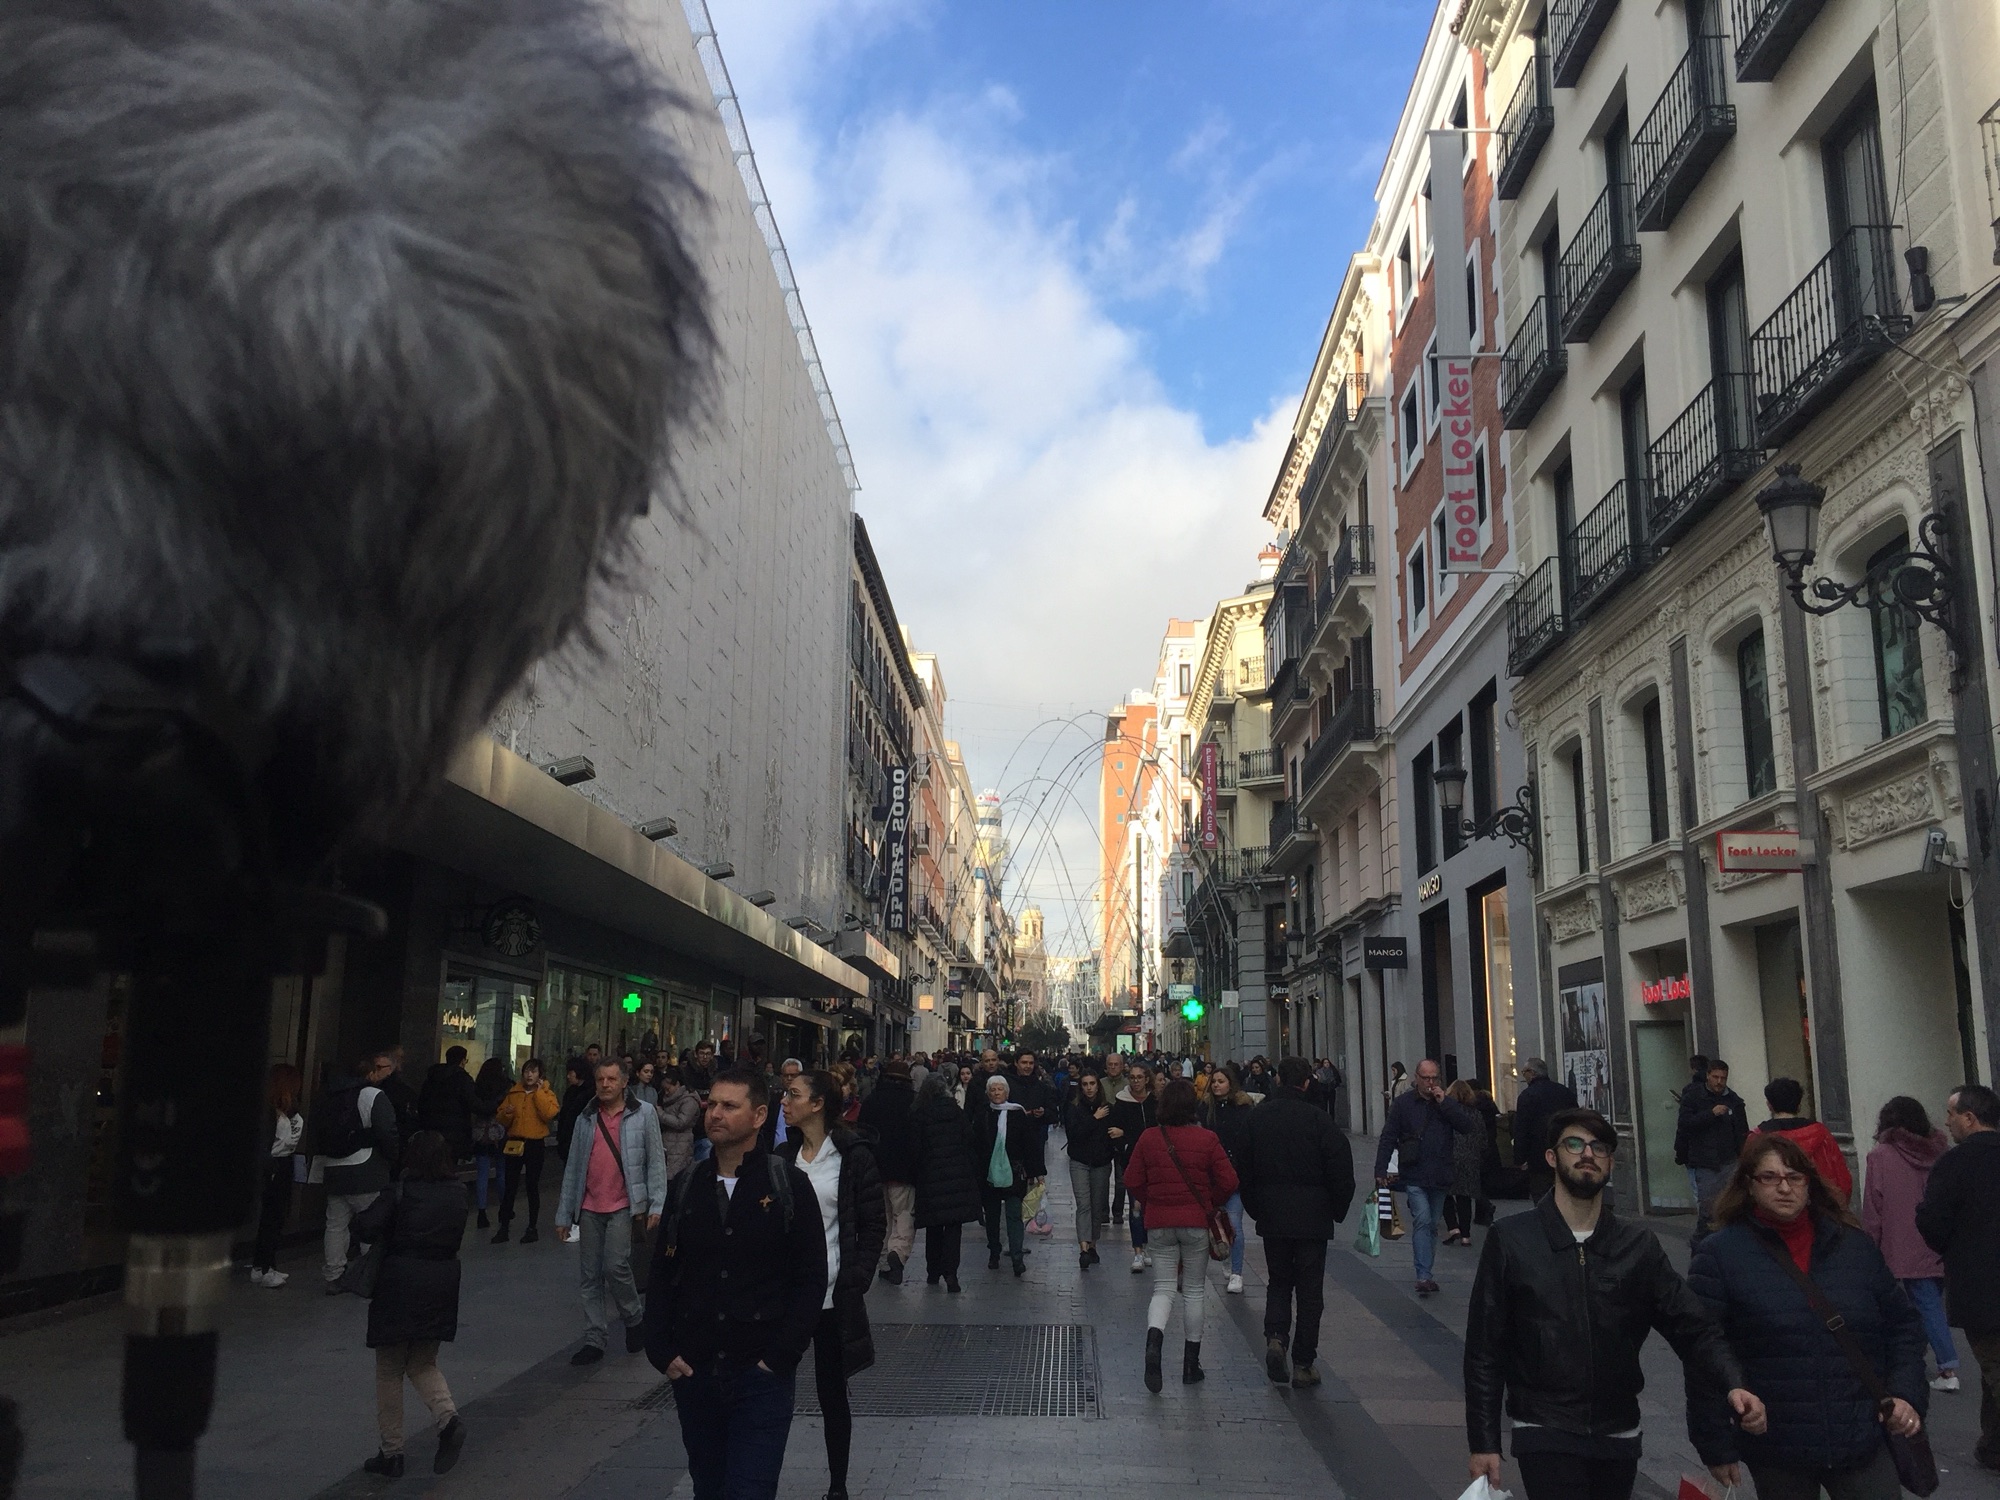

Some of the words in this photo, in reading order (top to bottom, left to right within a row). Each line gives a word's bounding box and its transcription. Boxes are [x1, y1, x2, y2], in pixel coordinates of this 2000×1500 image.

[1443, 363, 1474, 476] Locker
[1448, 488, 1478, 562] Foot
[892, 768, 905, 832] 2000
[1727, 846, 1754, 857] Foot
[1757, 846, 1797, 857] Locker
[890, 842, 904, 929] SPORT
[1418, 874, 1441, 902] MANGO
[1368, 949, 1404, 957] MANGO
[1641, 979, 1664, 1005] Foot
